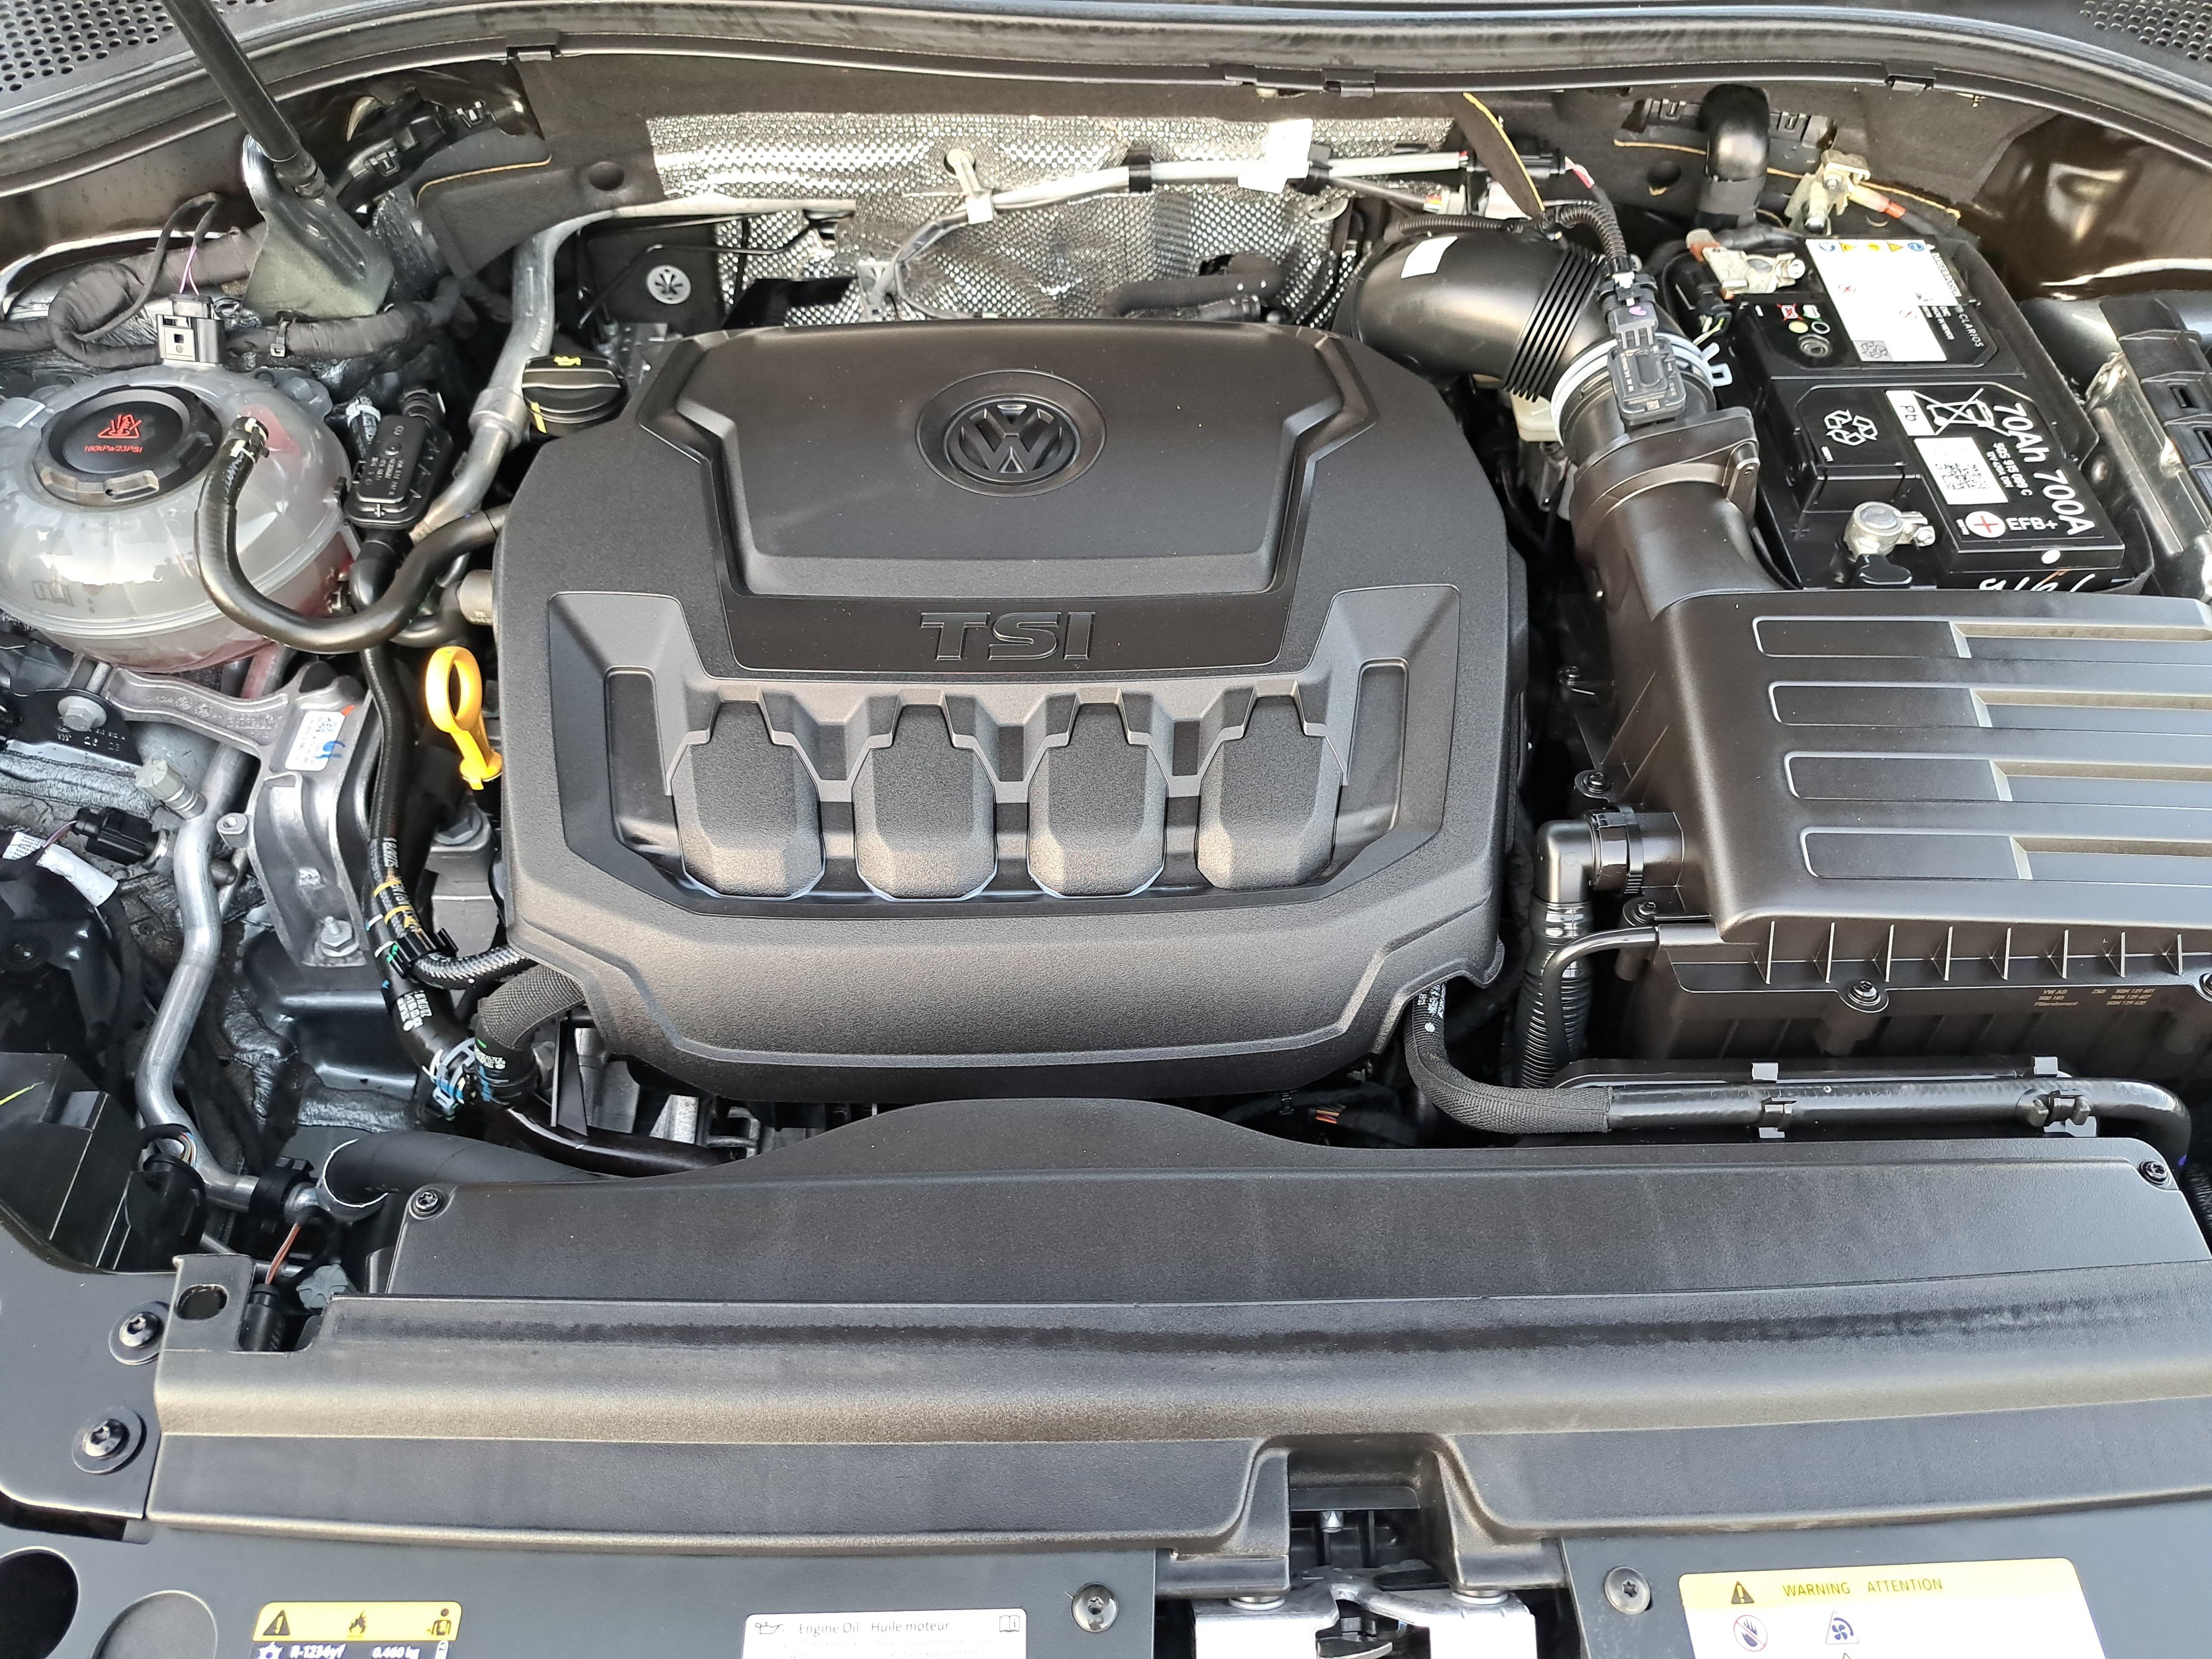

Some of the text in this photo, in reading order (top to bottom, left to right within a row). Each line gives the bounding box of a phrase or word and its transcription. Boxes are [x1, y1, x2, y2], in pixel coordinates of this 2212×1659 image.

[1959, 314, 1984, 347] CLARIOS
[1900, 405, 1917, 421] Pb
[951, 398, 1072, 480] VW
[1993, 403, 2050, 463] 70Ah
[2034, 469, 2095, 535] 700A
[2021, 488, 2033, 496] C
[2005, 517, 2058, 531] EFB+
[920, 612, 1095, 661] TSI
[1782, 1578, 1943, 1597] WARNING ATTENTION
[799, 1621, 950, 1637] Engine Oil Huile moteur
